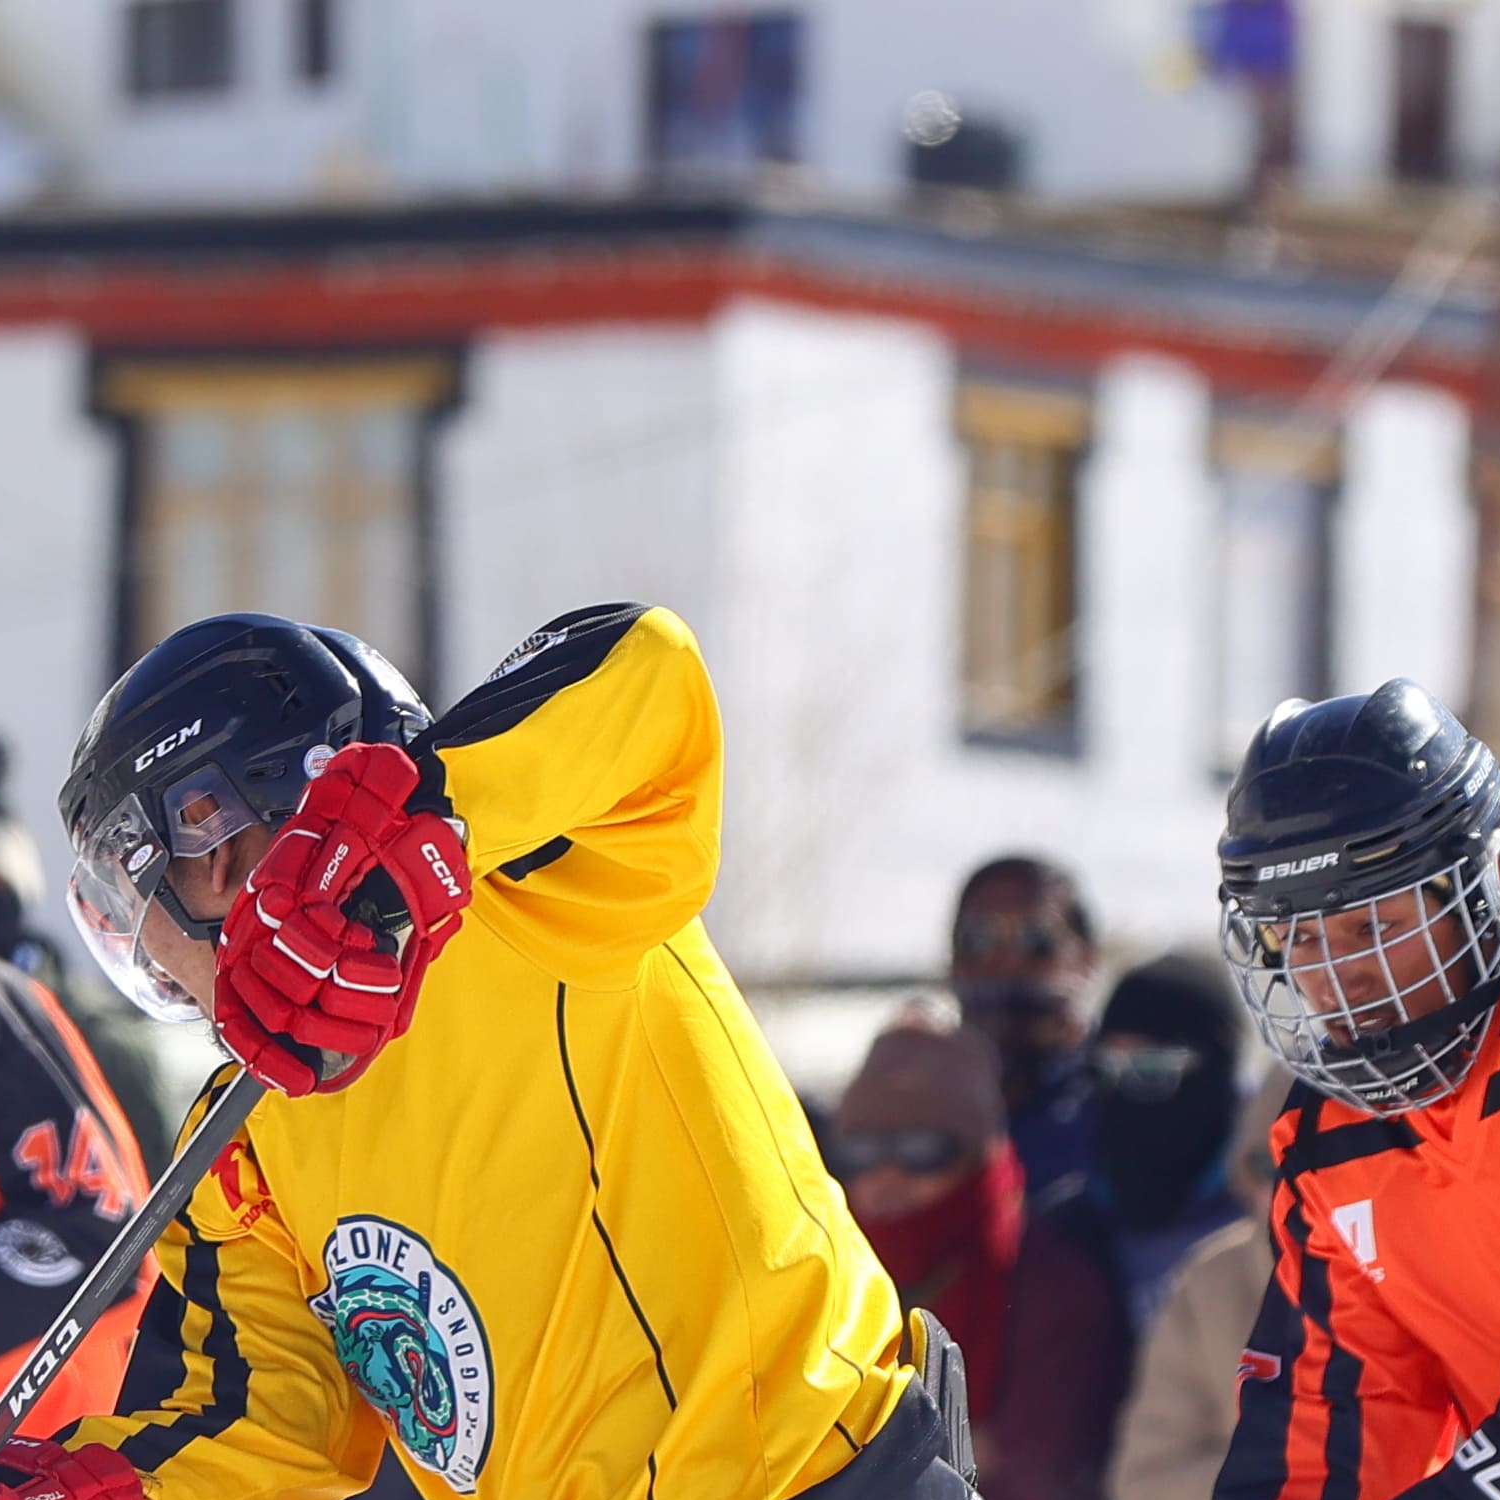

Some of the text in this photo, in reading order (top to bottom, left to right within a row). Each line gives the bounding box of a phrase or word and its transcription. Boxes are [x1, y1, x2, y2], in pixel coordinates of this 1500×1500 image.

[134, 719, 203, 773] CCM
[319, 842, 350, 892] TACKS
[419, 842, 463, 898] CCM
[1258, 851, 1341, 881] BAUER
[12, 1105, 131, 1223] 14
[8, 1317, 84, 1419] CCM
